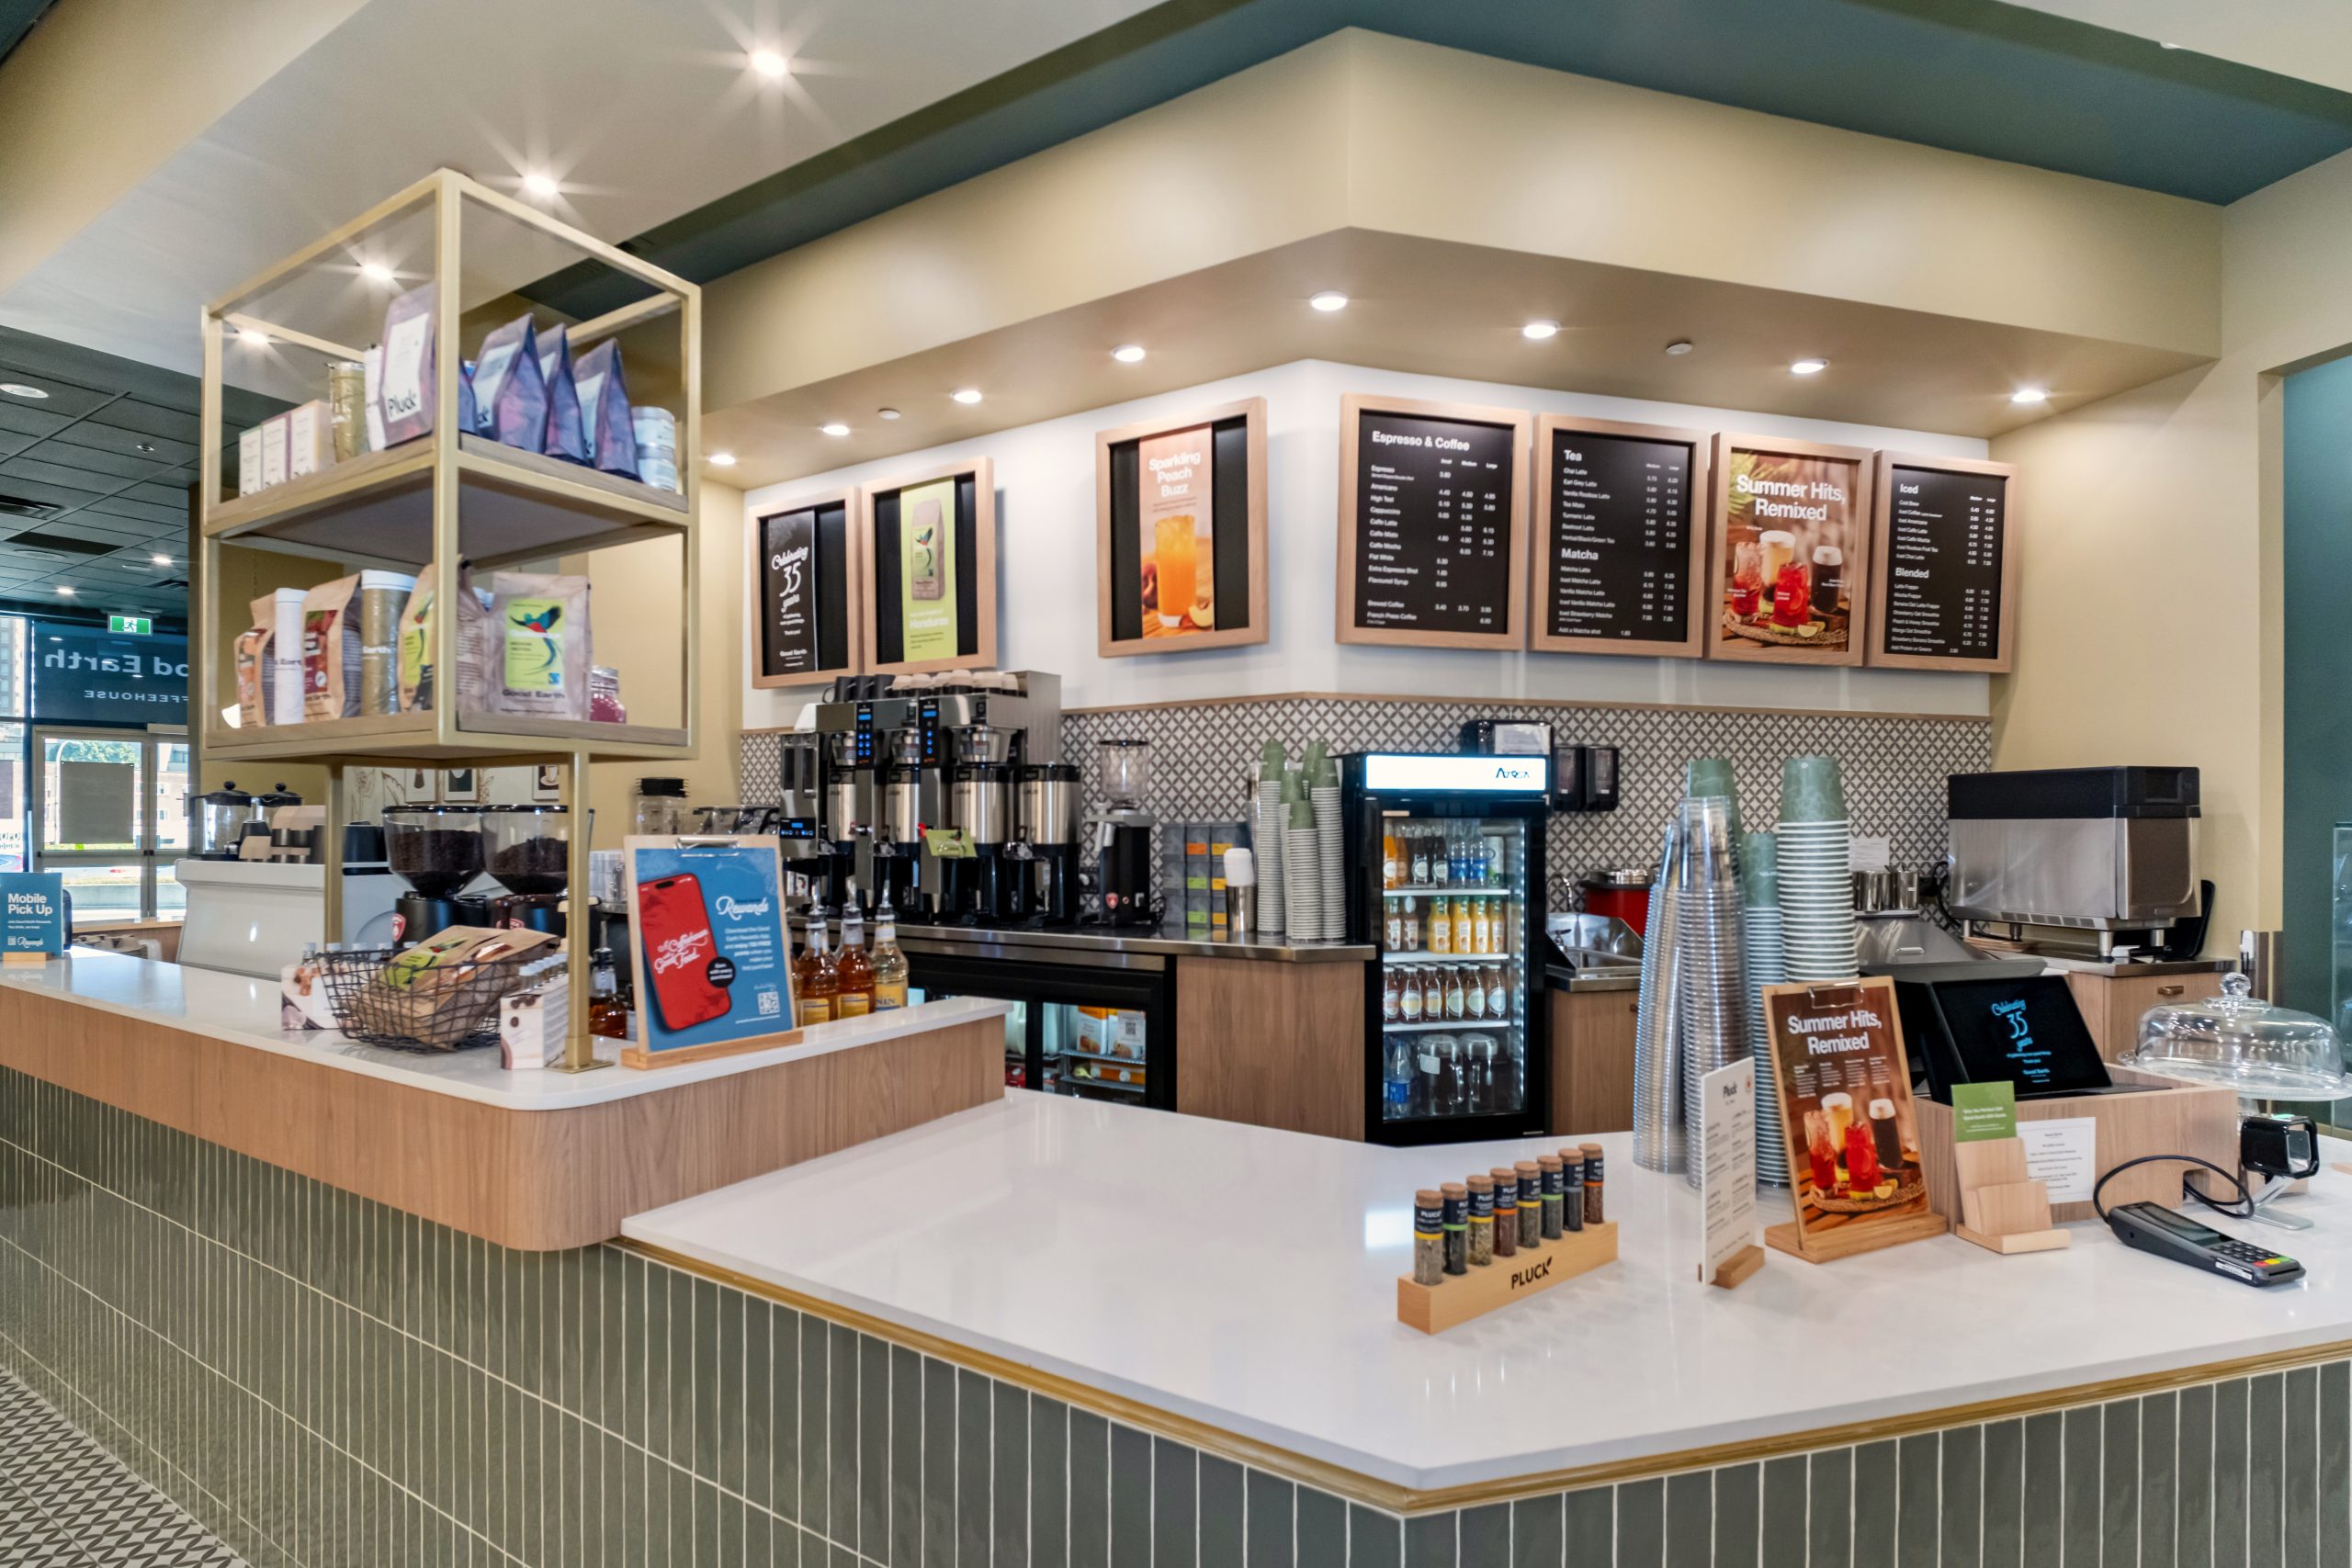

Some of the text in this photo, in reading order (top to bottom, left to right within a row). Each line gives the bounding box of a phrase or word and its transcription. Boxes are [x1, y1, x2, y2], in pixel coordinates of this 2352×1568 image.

[1373, 431, 1470, 451] Espresso & Coffee
[1148, 452, 1201, 471] Sparkling
[1564, 449, 1582, 461] Tea
[1157, 467, 1192, 484] Peach
[1161, 483, 1189, 498] Buzz
[1736, 474, 1846, 505] Summer Hits,
[1900, 483, 1918, 494] Iced
[1755, 498, 1826, 521] Remixed
[1562, 547, 1599, 560] Matcha
[779, 561, 801, 597] 35
[1895, 567, 1929, 579] Blended
[8, 893, 47, 904] Mobile
[8, 904, 52, 916] Pick Up
[715, 896, 769, 921] Rewards
[875, 998, 896, 1007] NIN
[1788, 1010, 1882, 1034] Summer Hits,
[2007, 1011, 2028, 1039] 35
[1807, 1032, 1870, 1055] Remixed
[1511, 1263, 1550, 1289] PLUCK
